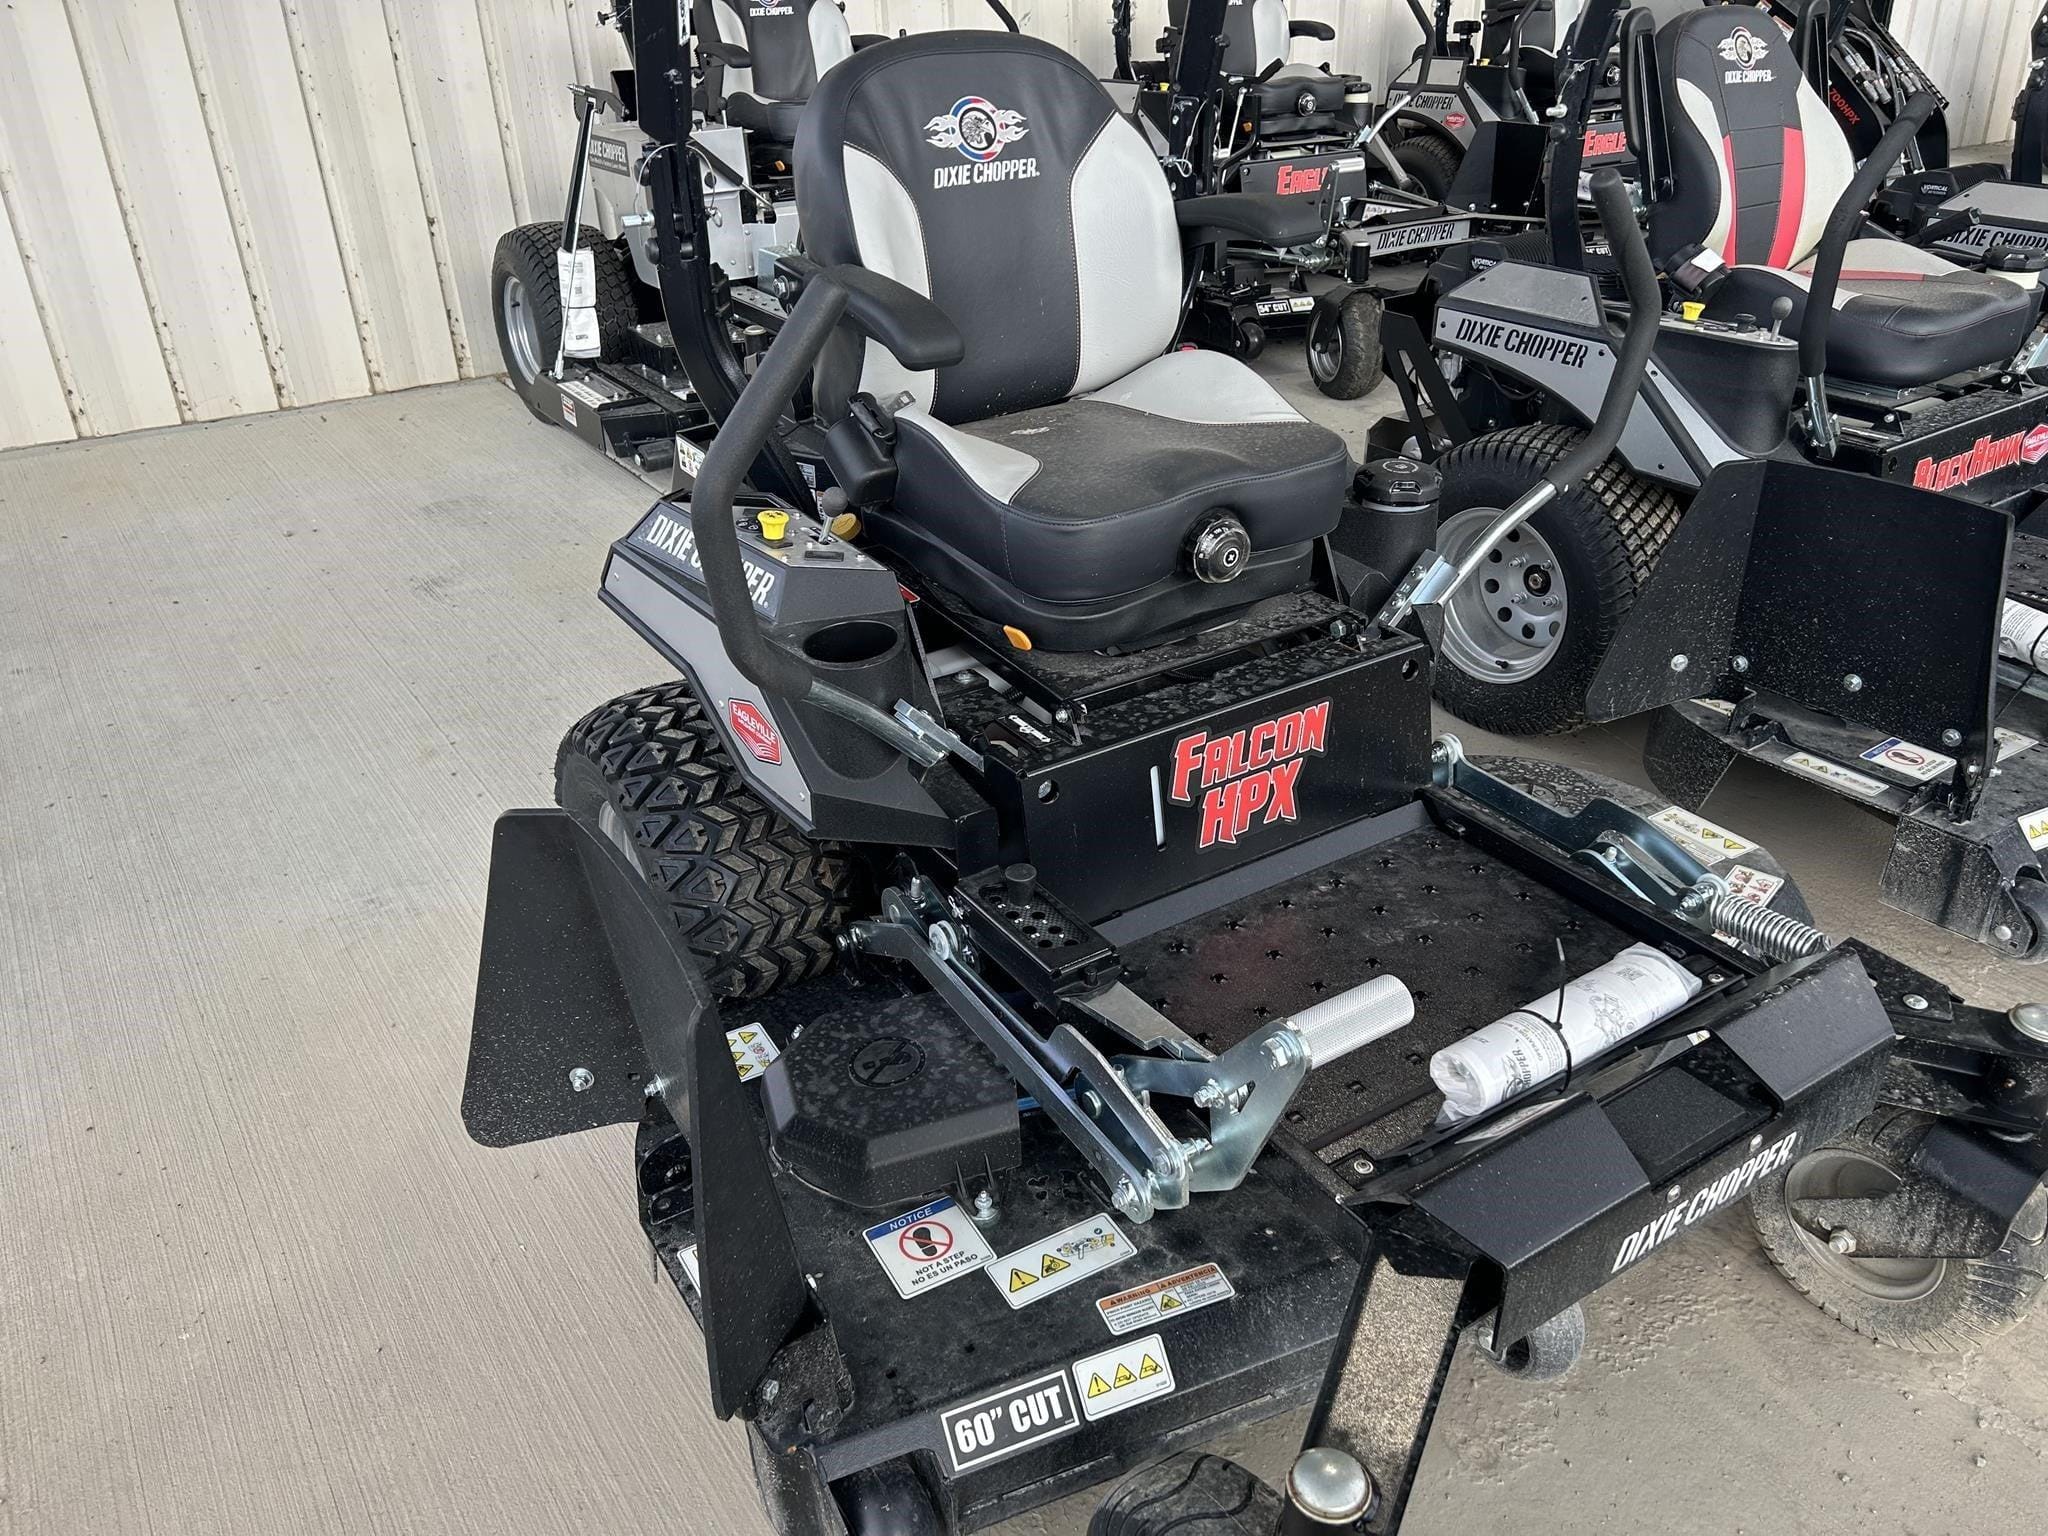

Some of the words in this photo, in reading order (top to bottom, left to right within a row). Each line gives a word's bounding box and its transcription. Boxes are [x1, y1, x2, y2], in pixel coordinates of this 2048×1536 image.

[1725, 70, 1743, 84] DIXIE
[1415, 94, 1454, 110] CHOPPER
[1828, 87, 1861, 125] 700HPX
[1582, 130, 1627, 157] EAGLE
[934, 163, 971, 189] DIXIE
[1377, 229, 1404, 251] DIXIE
[1408, 223, 1455, 246] CHOPPER
[1272, 302, 1287, 312] CUT
[1455, 318, 1505, 349] DIXIE
[1504, 329, 1588, 369] CHOPPER
[646, 514, 695, 561] DIXIE
[732, 703, 777, 744] EAGLEVILLE
[1172, 700, 1330, 802] FALCON
[1200, 757, 1303, 849] HPX
[1512, 1049, 1532, 1087] HOPPER
[1611, 1200, 1689, 1273] DIXIE
[1684, 1131, 1797, 1226] CHOPPER
[889, 1207, 933, 1231] NOTICE
[911, 1277, 925, 1286] NO
[927, 1271, 939, 1279] ES
[940, 1265, 953, 1274] UN
[955, 1253, 978, 1268] PASO
[915, 1264, 934, 1276] NOT
[936, 1260, 943, 1268] A
[943, 1251, 965, 1264] STEP
[1167, 1267, 1216, 1286] ADVERTENCIA
[1116, 1288, 1151, 1303] WARNING
[1008, 1385, 1064, 1433] CUT
